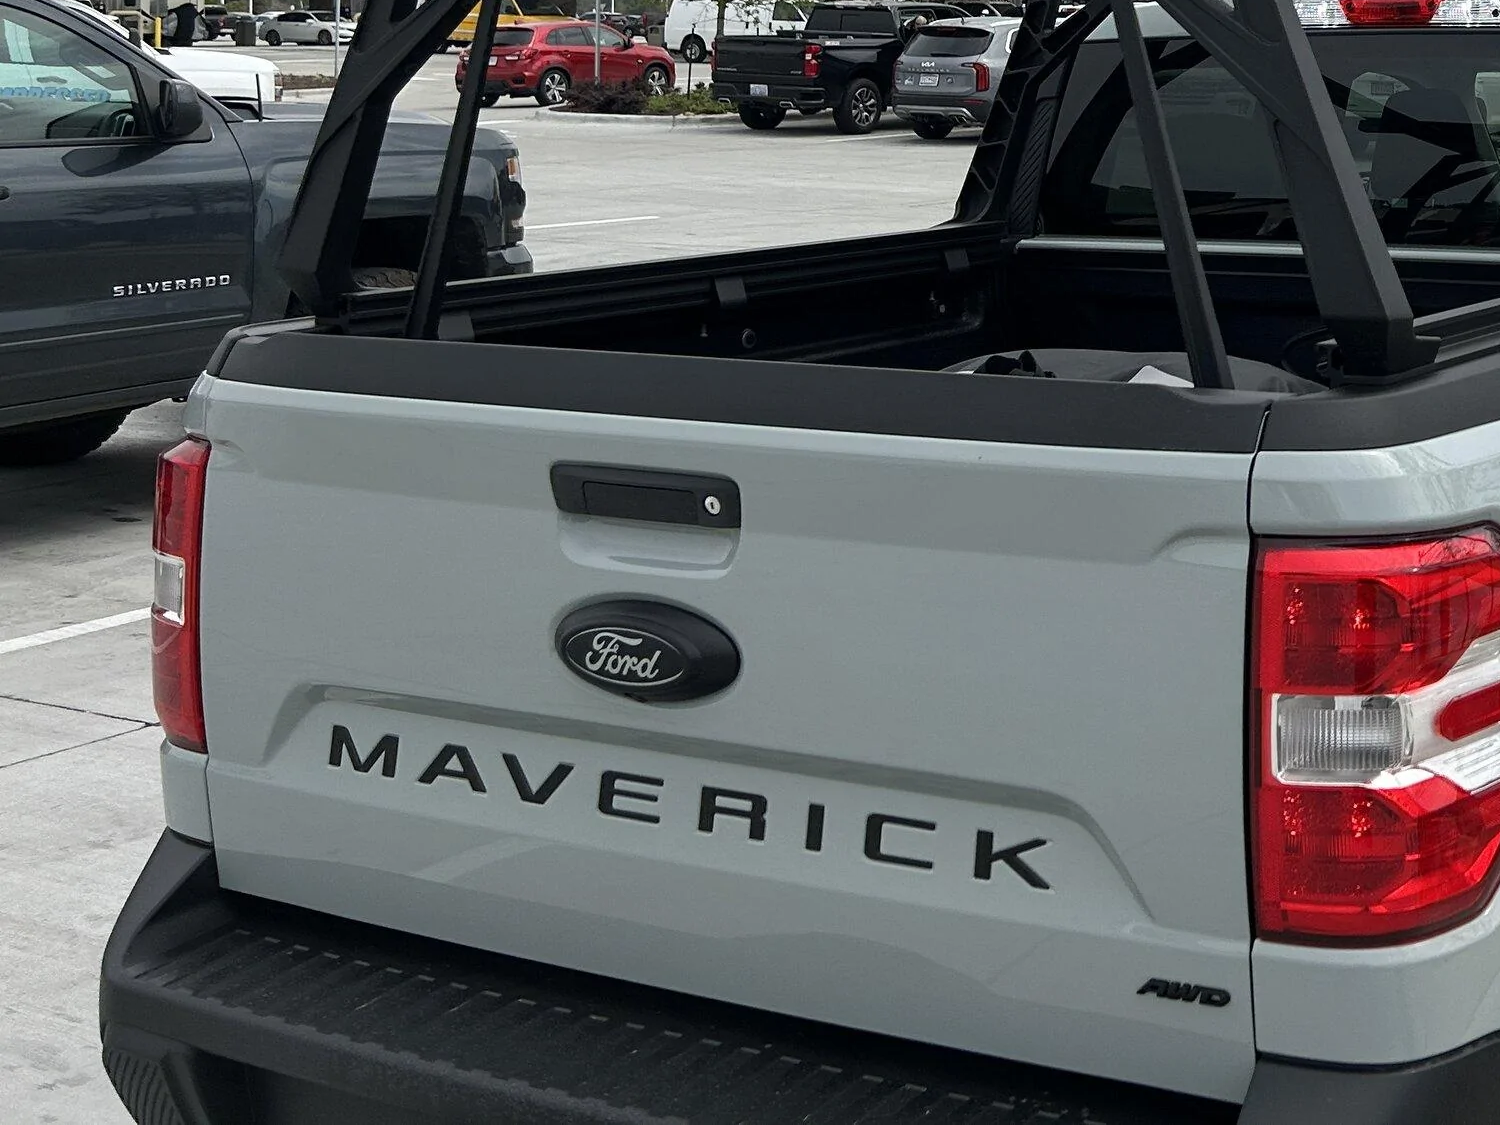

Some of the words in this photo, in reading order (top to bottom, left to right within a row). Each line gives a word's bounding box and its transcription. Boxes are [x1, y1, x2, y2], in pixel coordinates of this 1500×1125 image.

[113, 274, 231, 297] SILVERADO
[585, 631, 662, 679] Ford
[328, 723, 1056, 893] MAVERICK
[1136, 977, 1231, 1008] AWD
